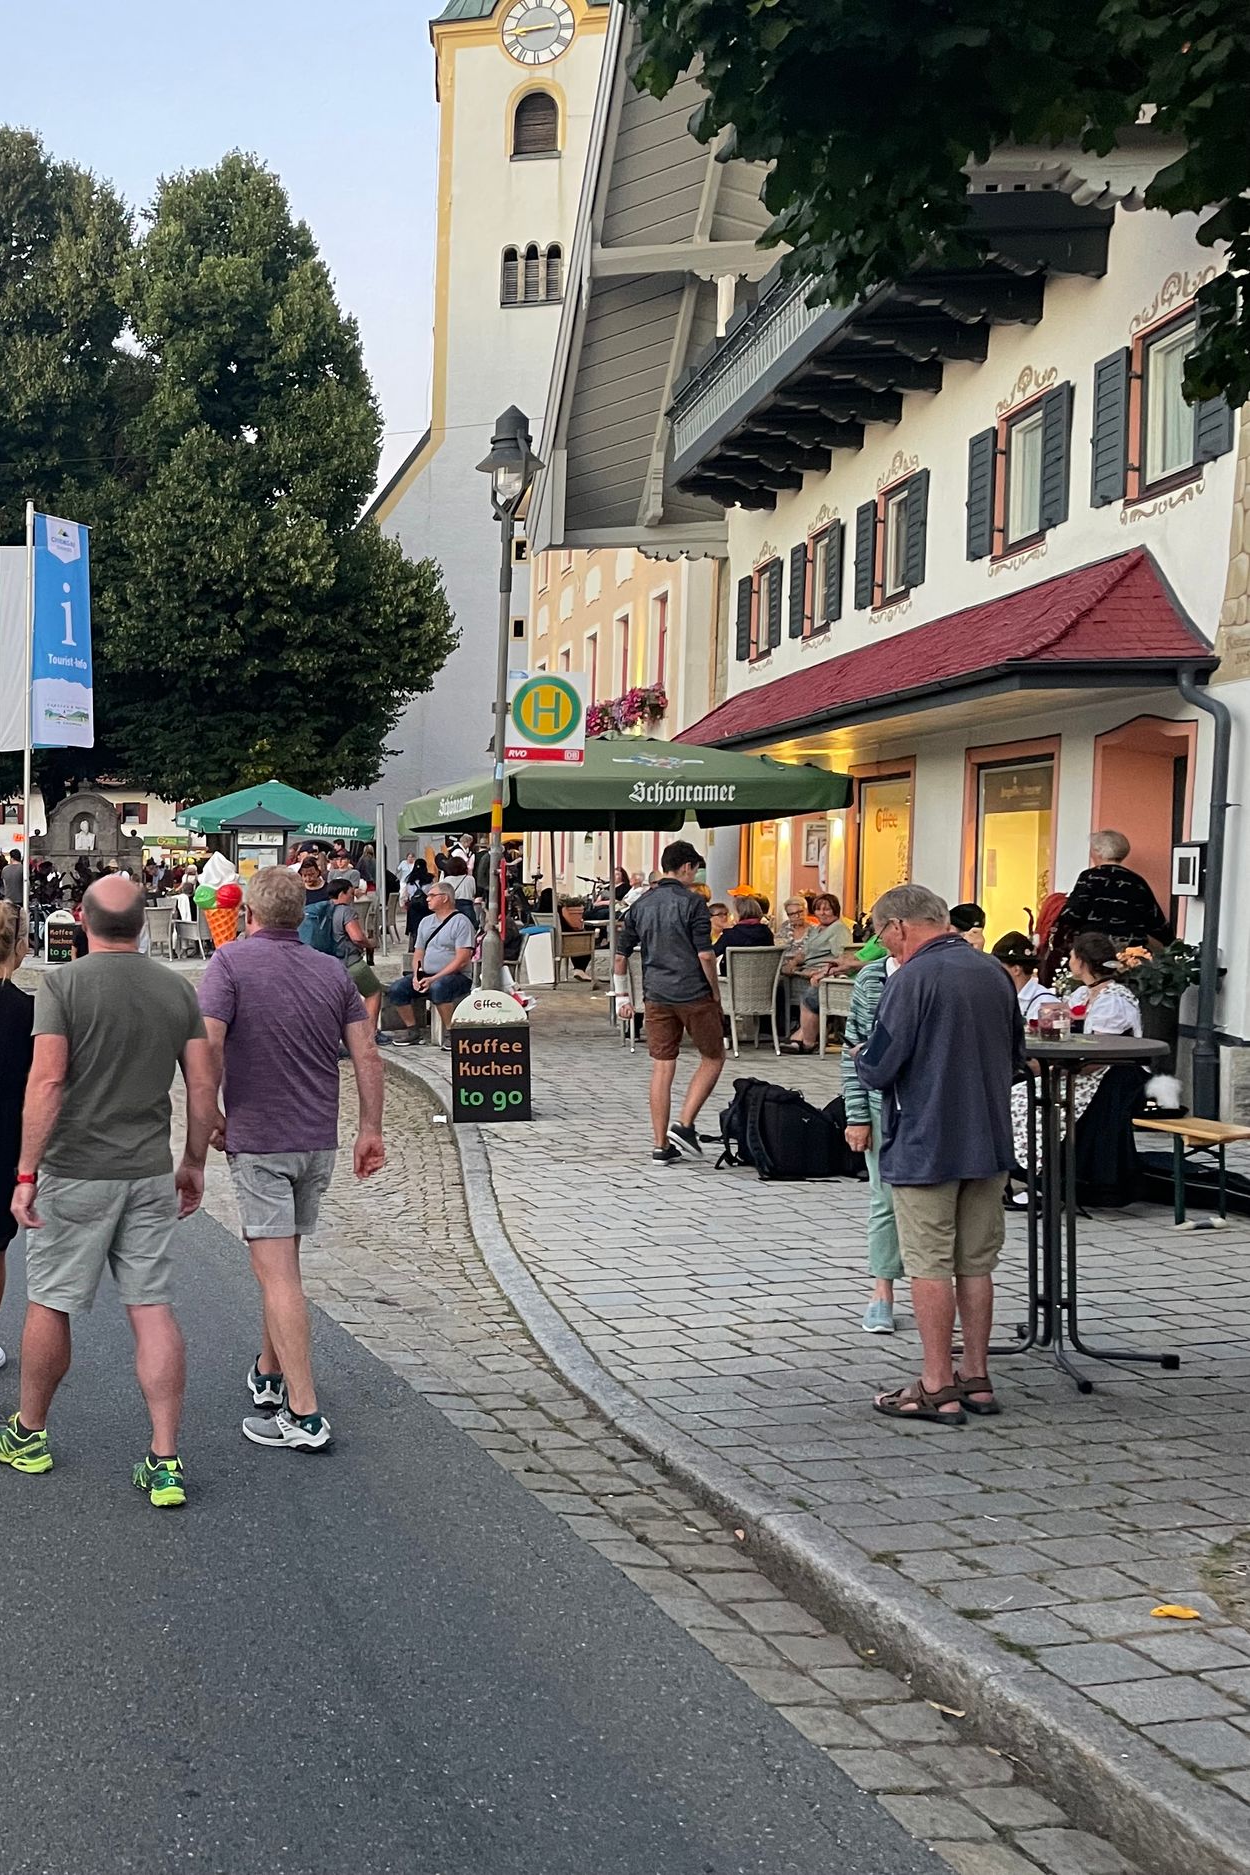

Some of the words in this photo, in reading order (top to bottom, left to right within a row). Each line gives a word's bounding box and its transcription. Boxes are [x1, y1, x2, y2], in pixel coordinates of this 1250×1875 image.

[48, 653, 88, 670] Tourist-Info
[533, 691, 561, 729] H
[508, 749, 527, 757] RVO
[628, 780, 736, 807] Schönramer
[304, 822, 359, 837] Schönramer
[50, 948, 59, 956] to
[458, 1039, 523, 1055] Kaffee
[459, 1061, 523, 1076] Kuchen
[460, 1088, 484, 1106] to
[492, 1090, 523, 1111] go
